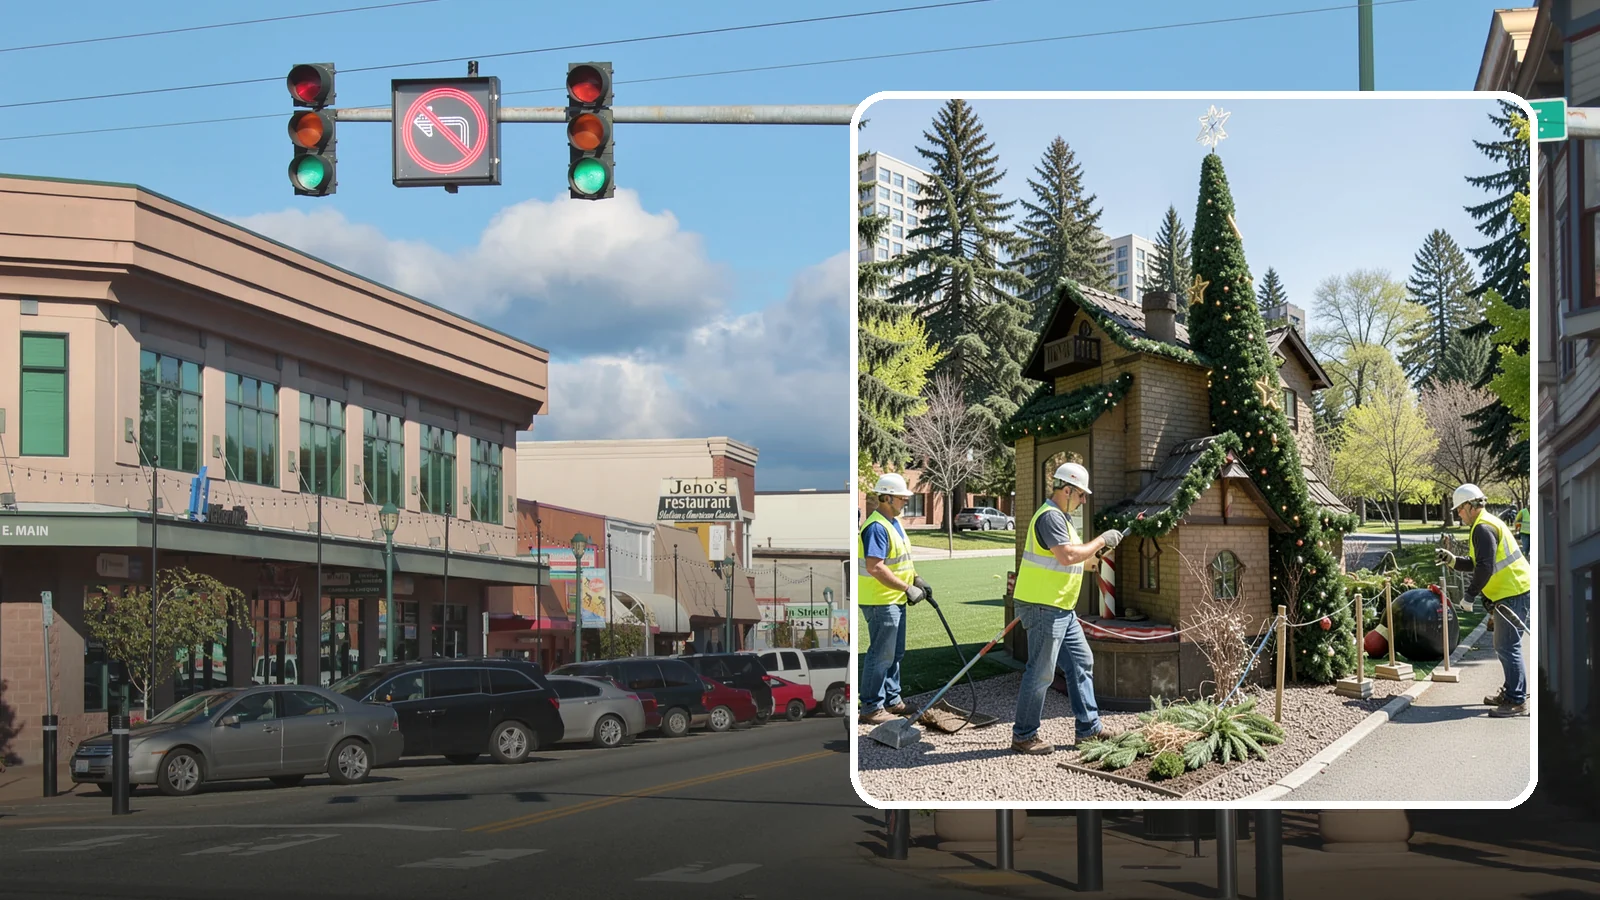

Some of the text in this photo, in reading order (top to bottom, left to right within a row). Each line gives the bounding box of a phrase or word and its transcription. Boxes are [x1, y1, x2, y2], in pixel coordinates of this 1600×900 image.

[669, 480, 727, 494] Jeno's
[665, 496, 731, 509] restaurant
[658, 510, 681, 519] Italian
[686, 509, 714, 519] American
[715, 509, 737, 519] Cuisine
[2, 525, 49, 536] E. MAIN
[797, 608, 828, 617] Street
